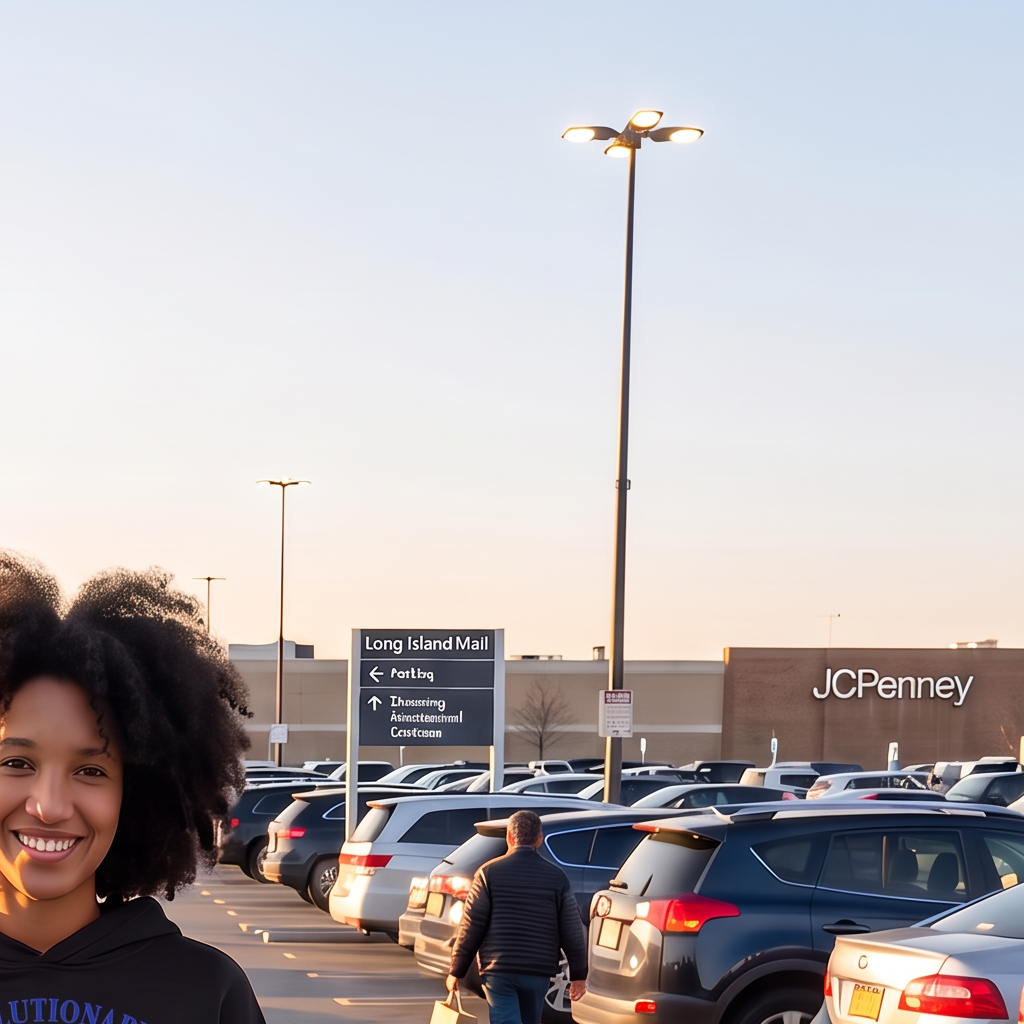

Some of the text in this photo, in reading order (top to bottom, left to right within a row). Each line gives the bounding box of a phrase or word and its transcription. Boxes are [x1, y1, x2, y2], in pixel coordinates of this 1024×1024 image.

[365, 636, 403, 655] Long
[407, 635, 453, 651] Island
[813, 668, 974, 706] JCPenney
